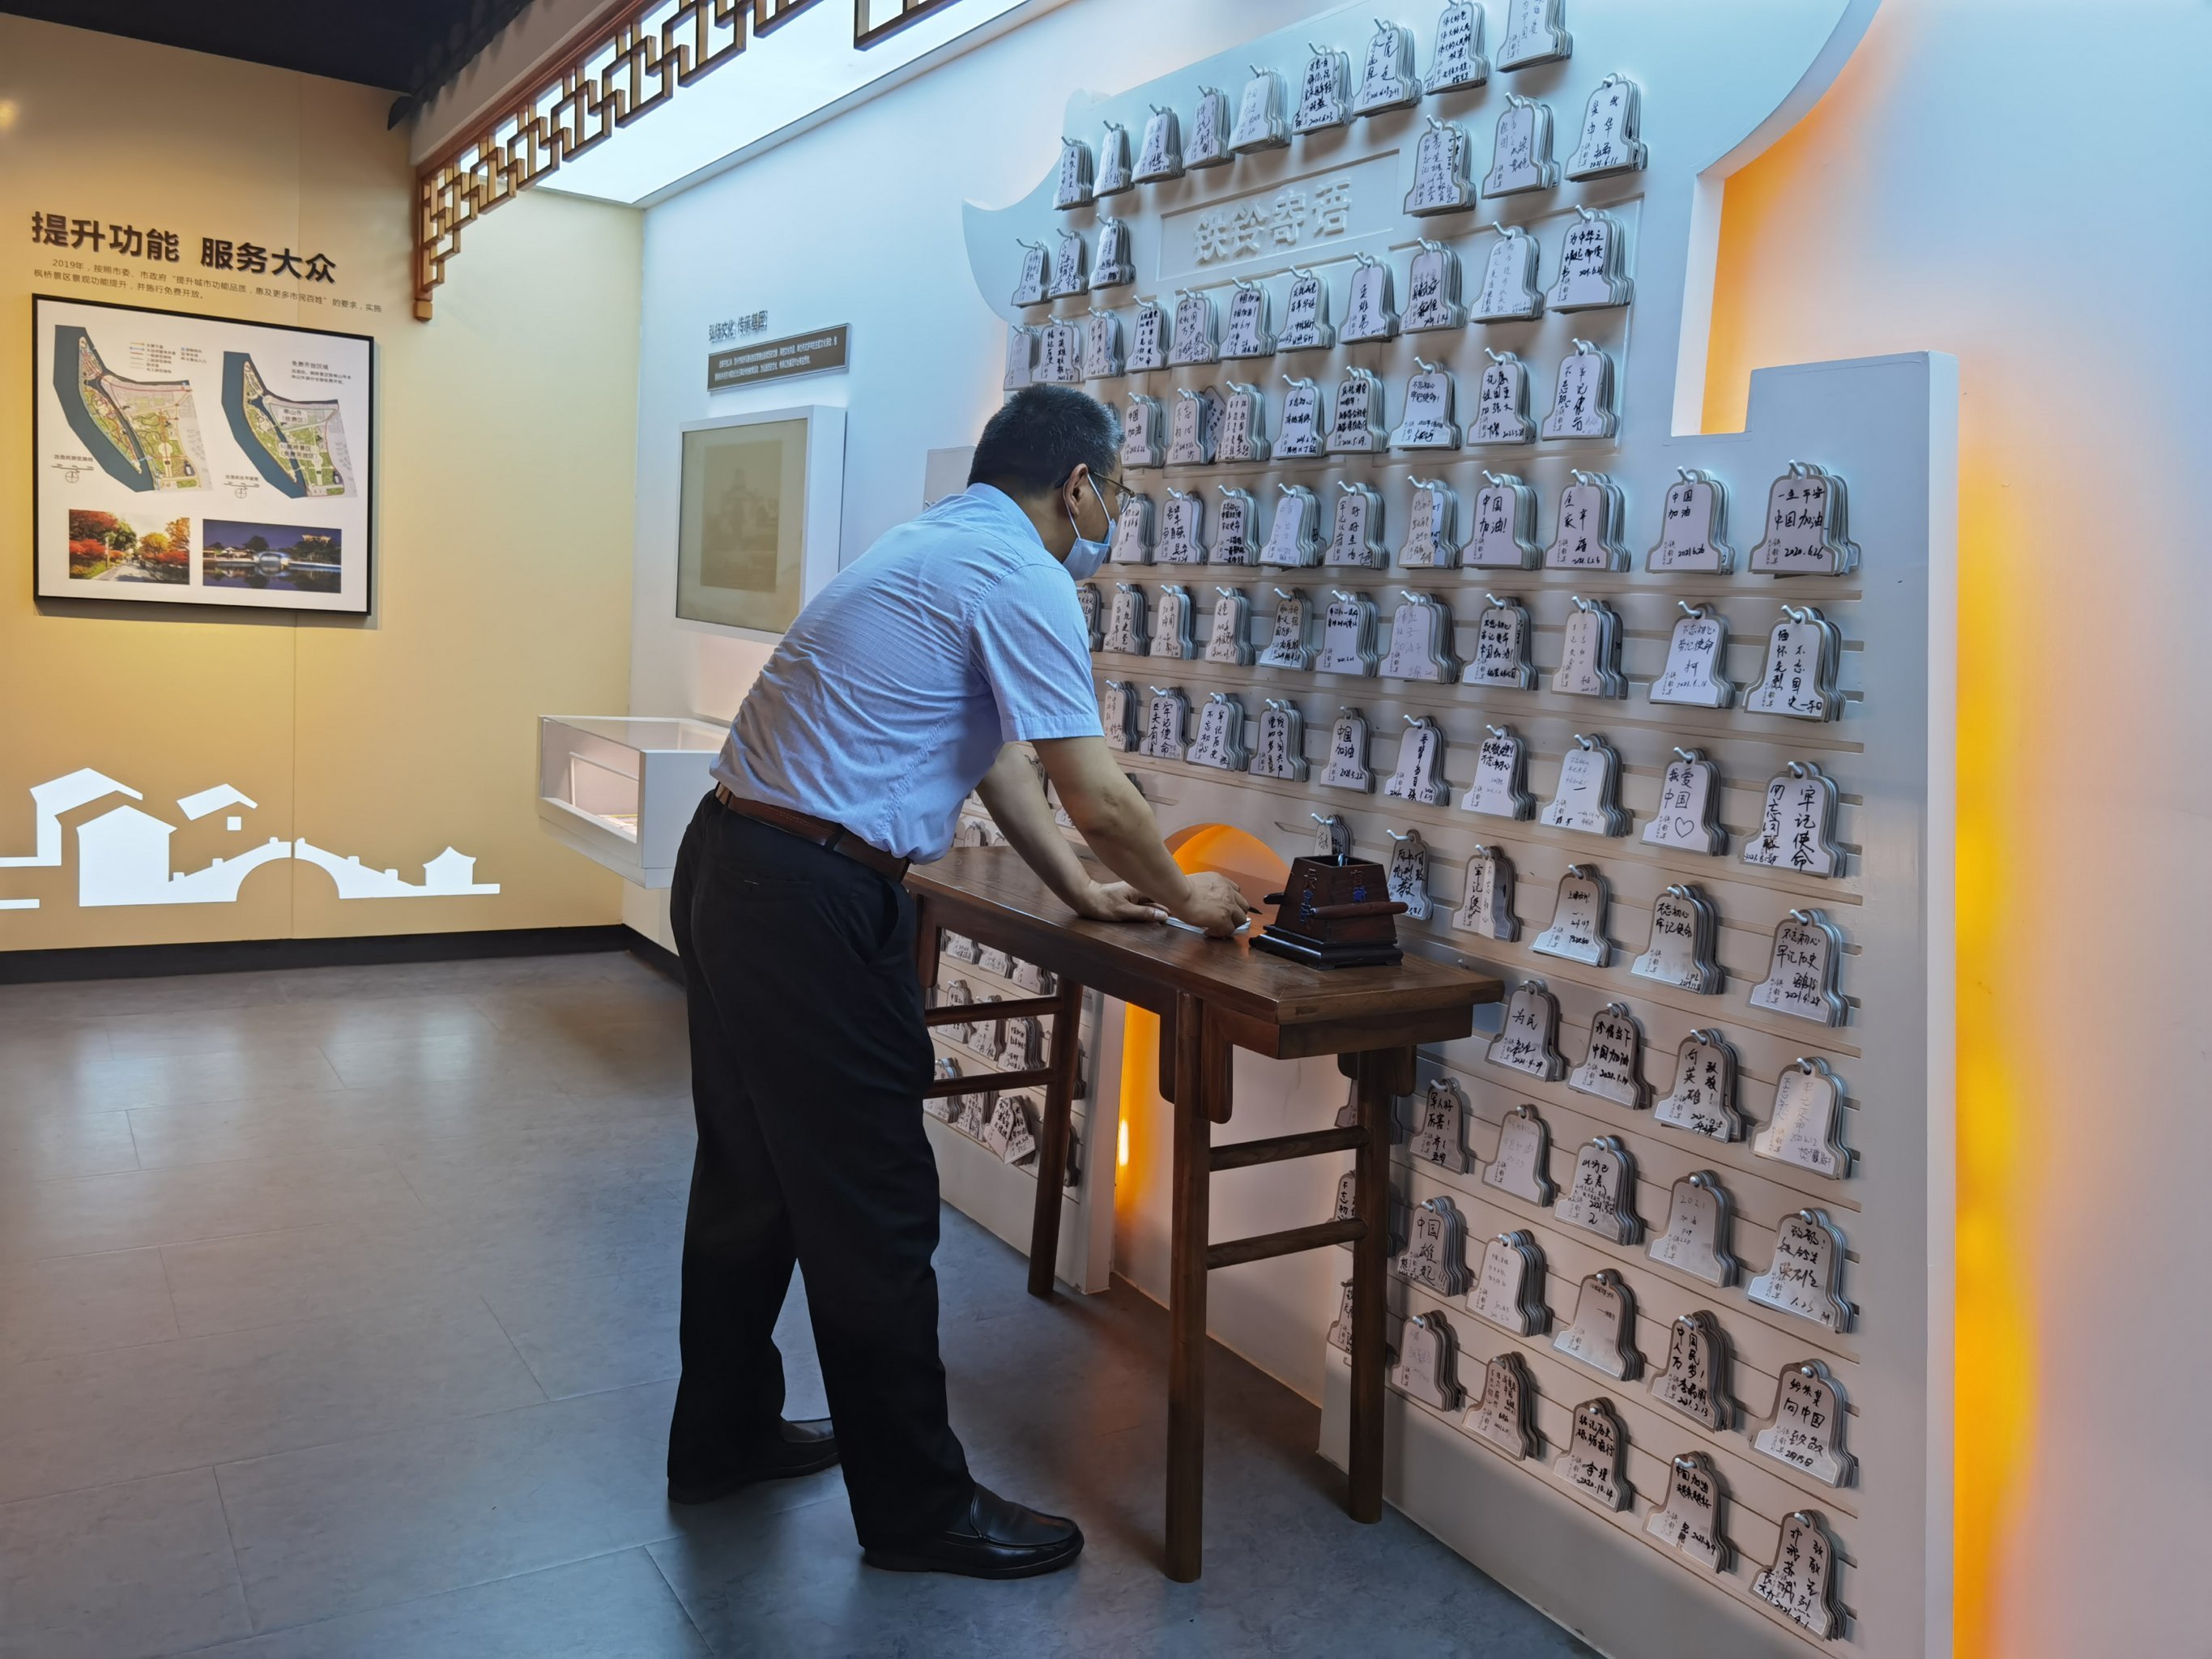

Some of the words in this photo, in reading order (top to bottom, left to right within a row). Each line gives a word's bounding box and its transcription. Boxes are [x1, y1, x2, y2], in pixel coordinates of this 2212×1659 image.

[1193, 179, 1350, 266] 铁铃寄语
[32, 211, 180, 262] 提升功能
[200, 237, 337, 284] 服务大众
[1570, 229, 1604, 245] 为中华之
[1482, 494, 1503, 516] 中国
[1671, 488, 1693, 504] 中国
[1778, 487, 1826, 505] 一生平安
[1668, 508, 1692, 520] 加油
[1774, 510, 1824, 531] 中国加油
[1160, 701, 1174, 759] 牢记使命
[1336, 724, 1353, 743] 中国
[1335, 743, 1355, 759] 加油
[1668, 767, 1694, 790] 我爱
[1664, 787, 1691, 809] 中国
[1790, 784, 1817, 872] 牢记使命
[1657, 902, 1690, 919] 不忘初心
[1655, 918, 1694, 940] 牢记使命
[1782, 928, 1822, 947] 不忘初心
[1776, 940, 1821, 971] 牢记历史
[1512, 1009, 1538, 1031] 为民
[1595, 1021, 1633, 1047] 珍惜当下
[1592, 1043, 1630, 1068] 中国加油
[1683, 1047, 1702, 1106] 向英雄
[1417, 1217, 1441, 1240] 中国
[1784, 1397, 1826, 1429] 向中国
[1789, 1430, 1824, 1457] 致敬
[1675, 1465, 1710, 1494] 中国加油
